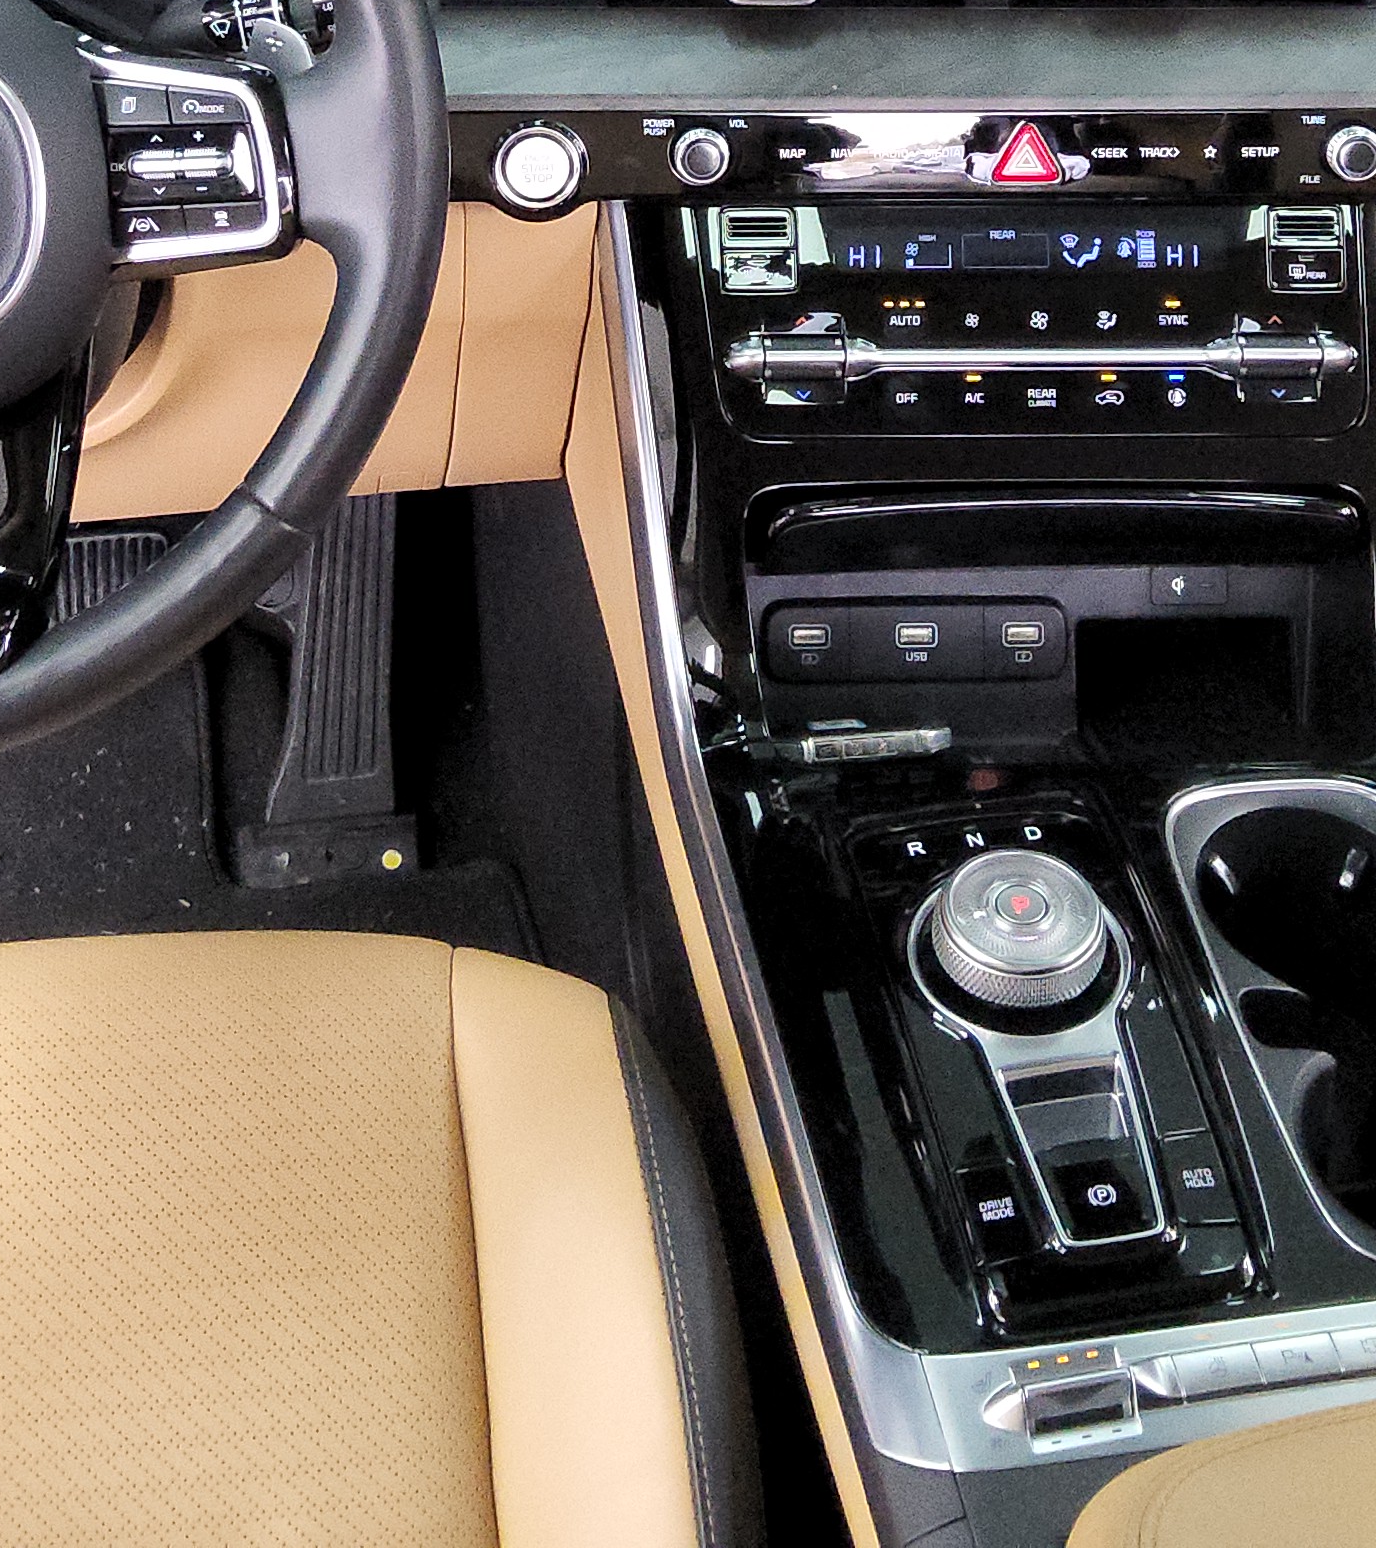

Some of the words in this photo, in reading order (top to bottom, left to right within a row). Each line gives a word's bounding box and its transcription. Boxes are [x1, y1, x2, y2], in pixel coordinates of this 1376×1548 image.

[643, 119, 675, 128] POWER
[728, 118, 749, 129] VOL
[778, 148, 807, 160] MAP
[1240, 146, 1280, 159] SETUP
[524, 173, 553, 183] STOP
[988, 229, 1016, 240] REAR
[889, 314, 921, 326] AUTO
[1158, 314, 1189, 326] SYNC
[895, 392, 919, 404] OFF
[964, 392, 985, 404] A/C
[1027, 389, 1056, 398] REAR
[905, 651, 928, 662] USB
[1023, 825, 1043, 841] D
[965, 832, 985, 848] N
[906, 841, 927, 857] R
[1182, 1168, 1212, 1180] AUTO
[979, 1197, 1013, 1213] DRIVE
[982, 1207, 1015, 1222] MODE
